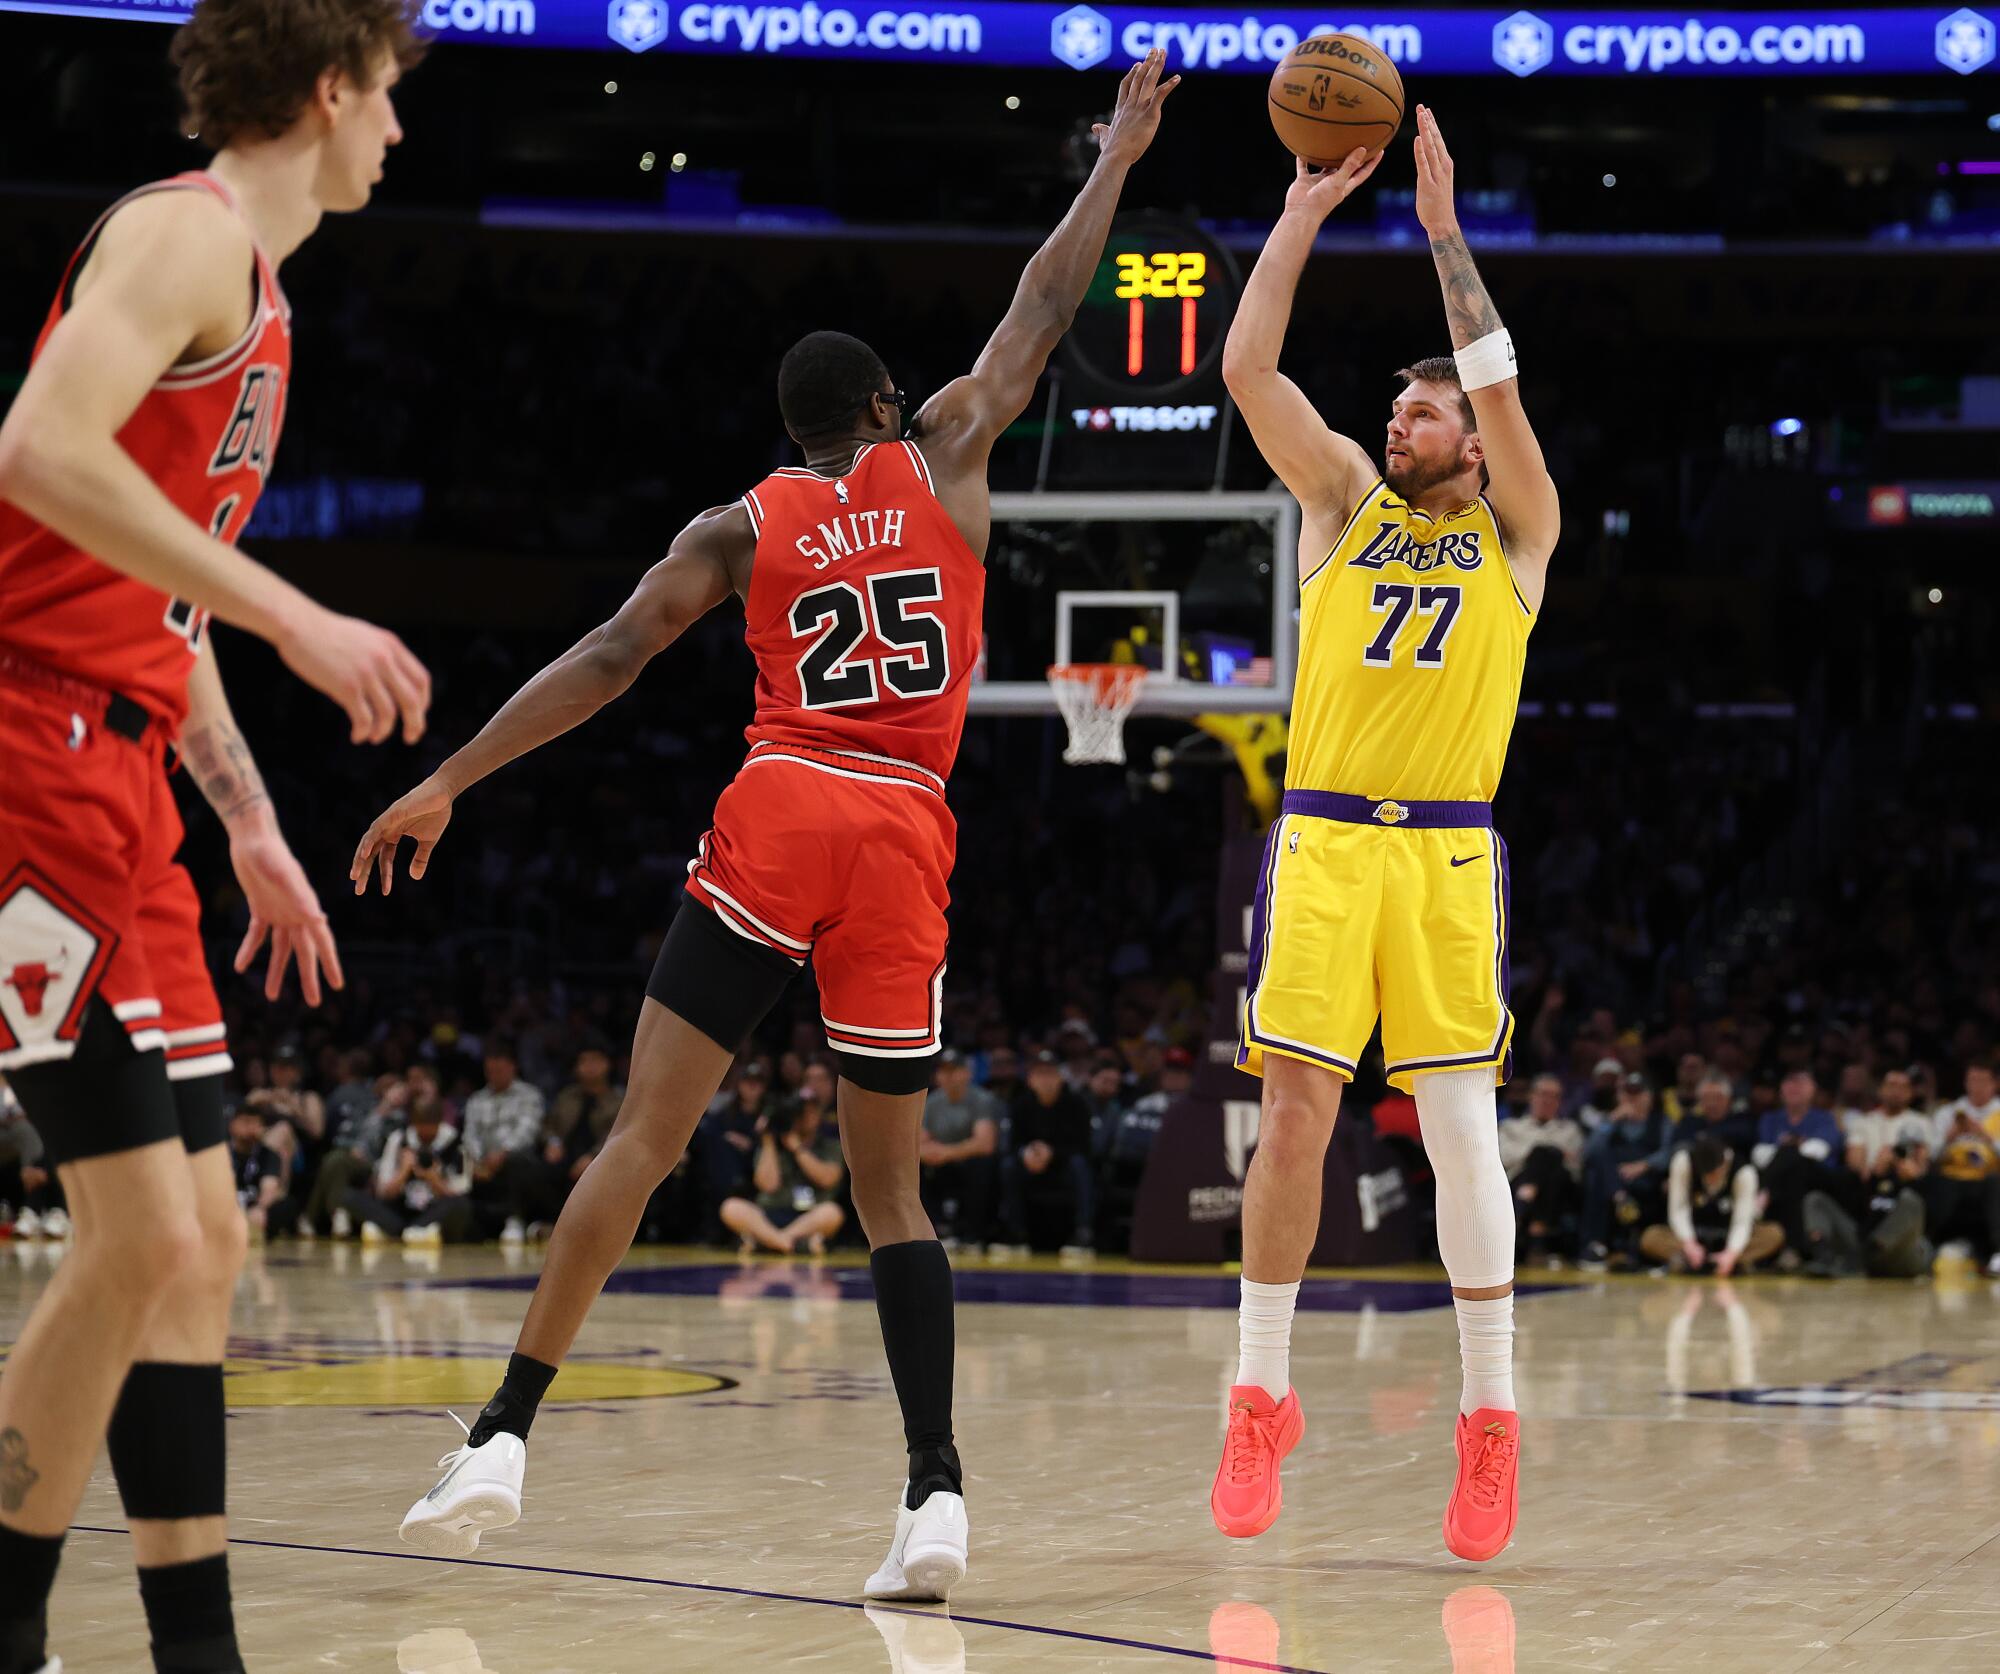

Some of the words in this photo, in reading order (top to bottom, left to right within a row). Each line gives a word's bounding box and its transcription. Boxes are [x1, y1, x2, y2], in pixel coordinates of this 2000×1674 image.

[679, 0, 981, 52] crypto.com
[1121, 16, 1422, 69] cryptom
[1562, 18, 1866, 72] crypto.com
[1294, 39, 1379, 78] Wilson
[1115, 252, 1206, 299] 3:22
[1128, 298, 1197, 377] 11
[1110, 405, 1217, 432] TISSOT
[795, 509, 906, 570] SMITH
[1348, 522, 1483, 573] LAKERS
[787, 566, 950, 711] 25
[1362, 583, 1463, 669] 77
